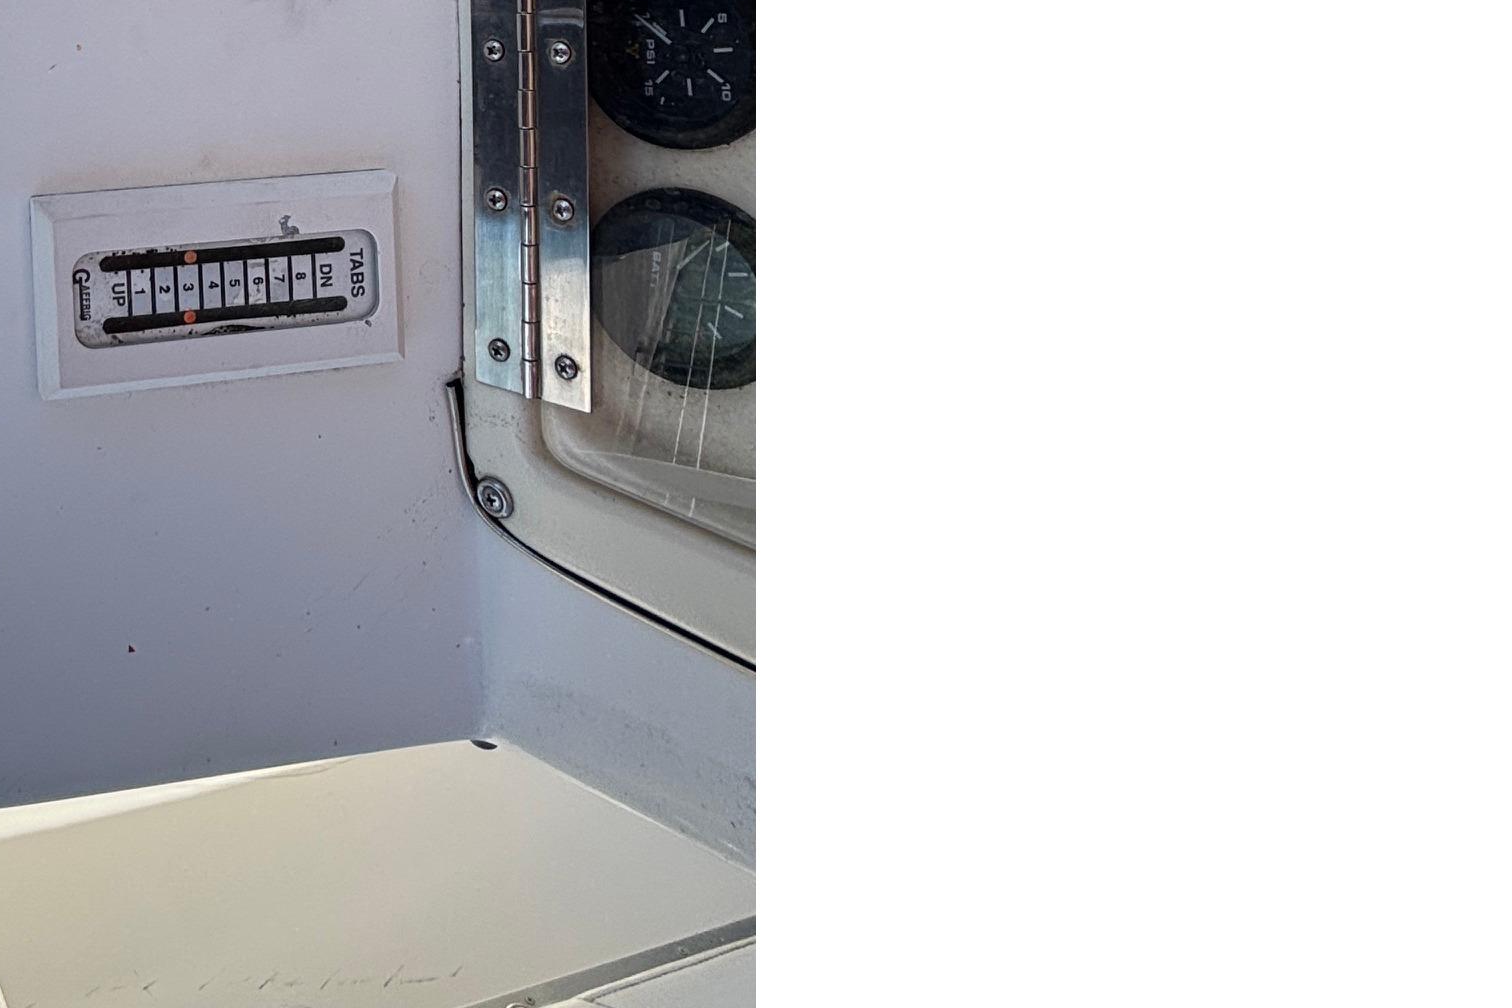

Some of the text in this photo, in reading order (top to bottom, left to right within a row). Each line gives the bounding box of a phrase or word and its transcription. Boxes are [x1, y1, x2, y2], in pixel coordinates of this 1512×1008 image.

[717, 13, 727, 23] 5
[646, 39, 655, 64] PSI
[644, 79, 653, 96] 15
[721, 83, 732, 101] 10
[295, 272, 306, 280] 8
[319, 263, 333, 288] DN
[349, 248, 365, 298] TABS
[230, 279, 240, 287] 5
[253, 277, 263, 285] 6
[274, 274, 285, 283] 7
[159, 285, 170, 294] 2
[183, 283, 194, 292] 3
[208, 281, 219, 289] 4
[112, 282, 126, 307] UP
